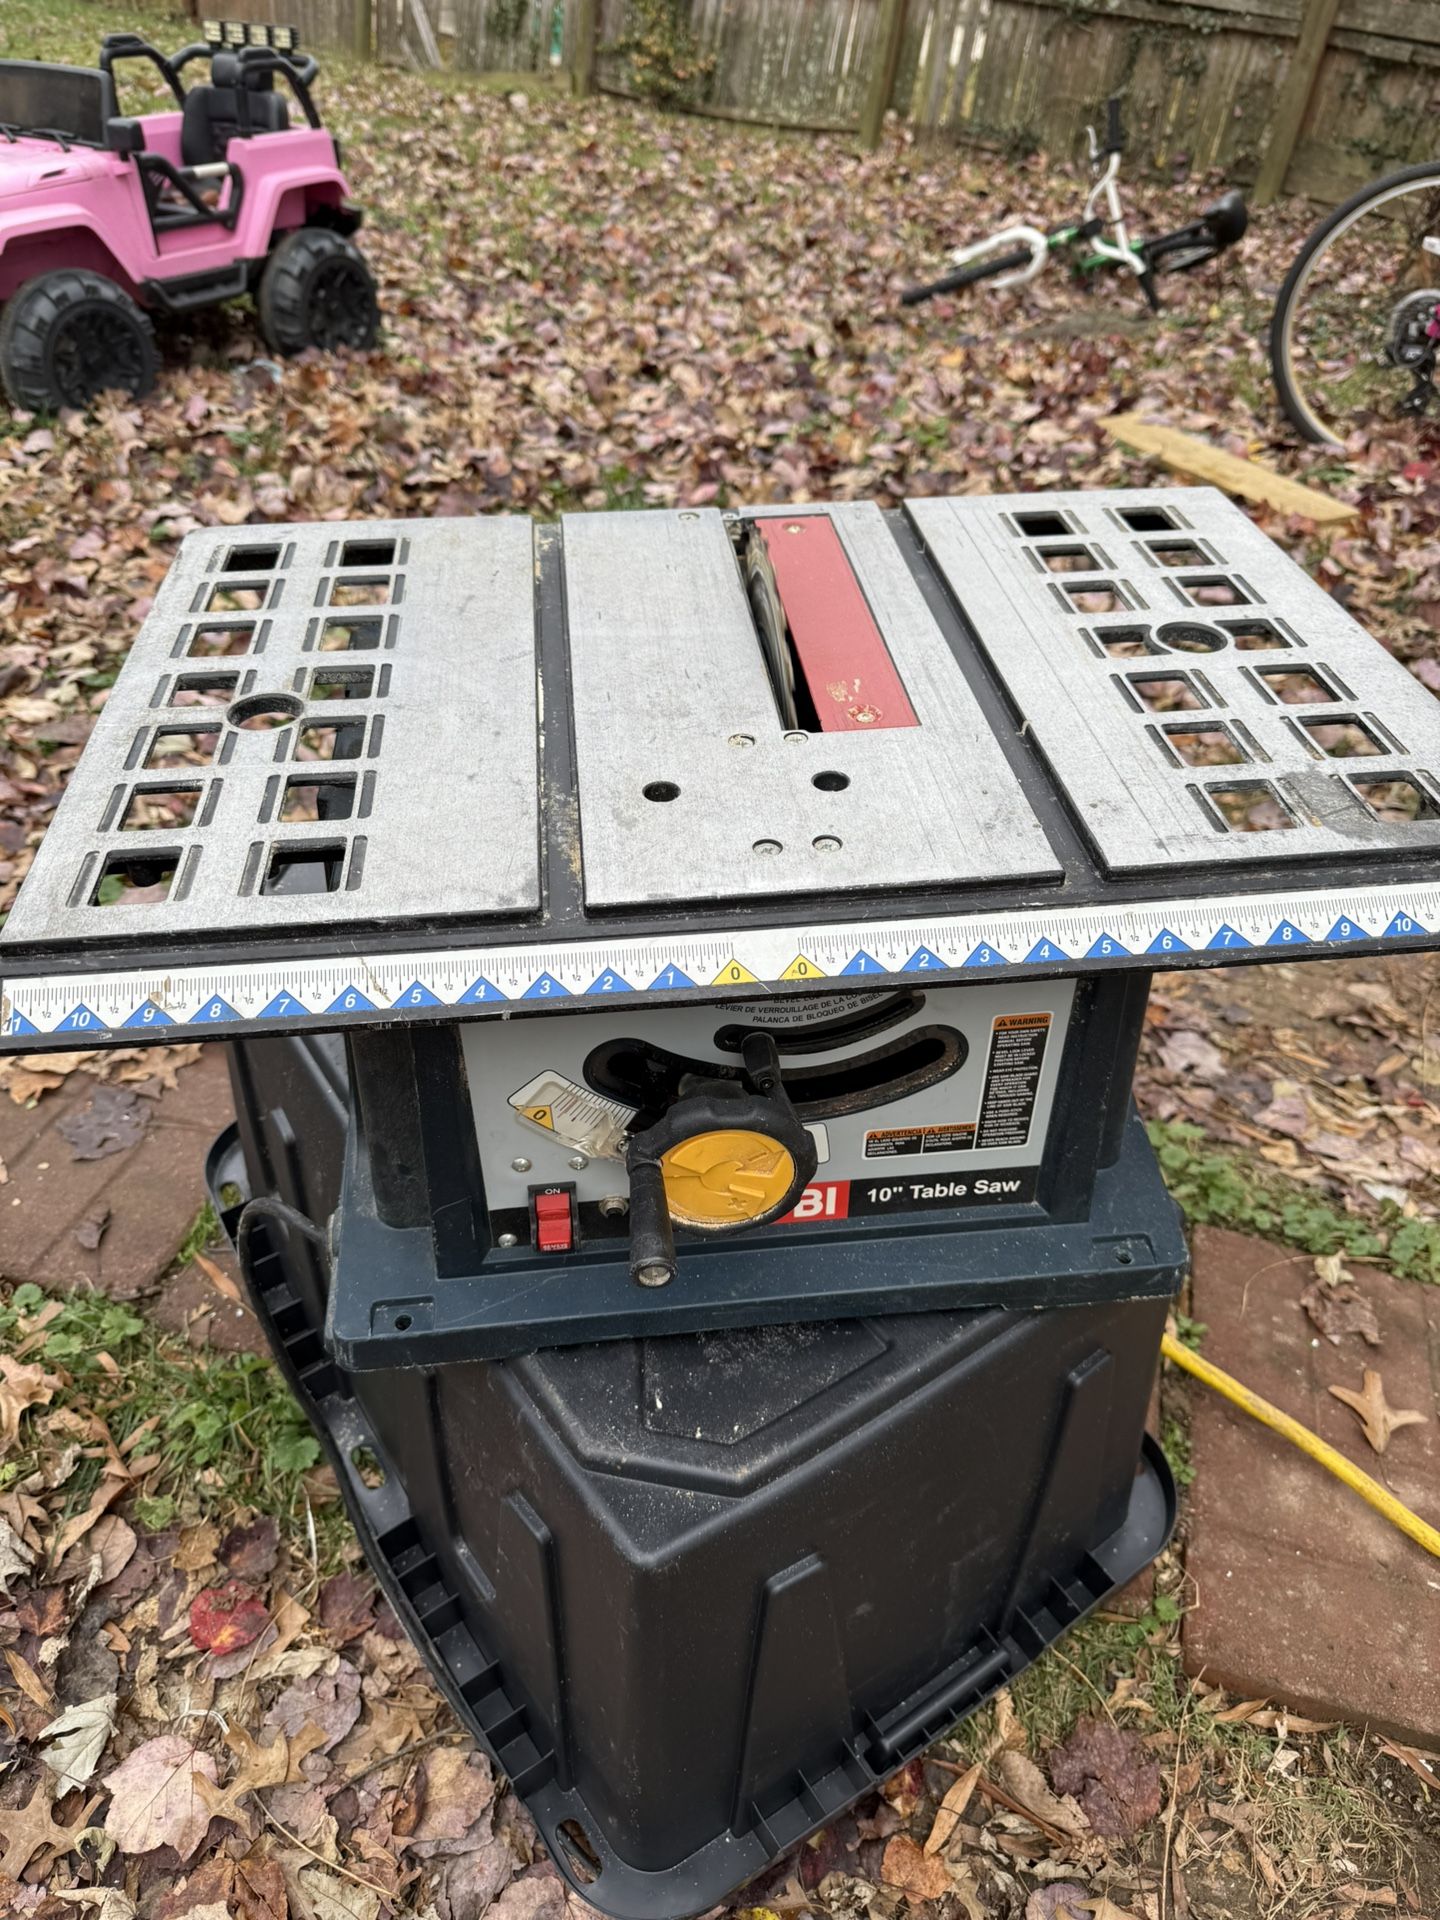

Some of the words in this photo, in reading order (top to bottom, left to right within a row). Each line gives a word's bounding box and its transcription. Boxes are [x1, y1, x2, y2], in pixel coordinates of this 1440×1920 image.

[798, 961, 808, 976] 0
[858, 957, 866, 971] 1
[919, 953, 929, 967] 2
[979, 948, 991, 962] 3
[1040, 944, 1050, 958] 4
[1101, 940, 1112, 954] 5
[1162, 935, 1173, 949] 6
[1222, 931, 1233, 945] 7
[1282, 926, 1292, 940] 8
[1340, 922, 1351, 936] 9
[1394, 917, 1412, 932] 10
[70, 1011, 91, 1027] 10
[143, 1007, 156, 1022] 9
[209, 1002, 222, 1018] 8
[279, 998, 291, 1013] 7
[345, 993, 356, 1008] 6
[411, 989, 422, 1003] 5
[475, 984, 486, 999] 4
[540, 980, 551, 994] 3
[602, 975, 613, 990] 2
[666, 971, 674, 986] 1
[730, 966, 741, 980] 0
[715, 1003, 744, 1013] LEVIER
[758, 1002, 819, 1014] VERROUILLAGE
[820, 1000, 833, 1009] DE
[833, 996, 845, 1005] LA
[752, 1015, 790, 1024] PALANCA
[792, 1015, 804, 1023] DE
[806, 1005, 845, 1021] BLOQUEO
[847, 1001, 860, 1010] DE
[1009, 1016, 1049, 1026] WARNING
[532, 1109, 547, 1120] 0
[544, 1187, 561, 1195] ON
[793, 1186, 837, 1218] BI
[867, 1186, 904, 1203] 10"
[910, 1181, 967, 1199] Table
[973, 1179, 1021, 1195] Saw
